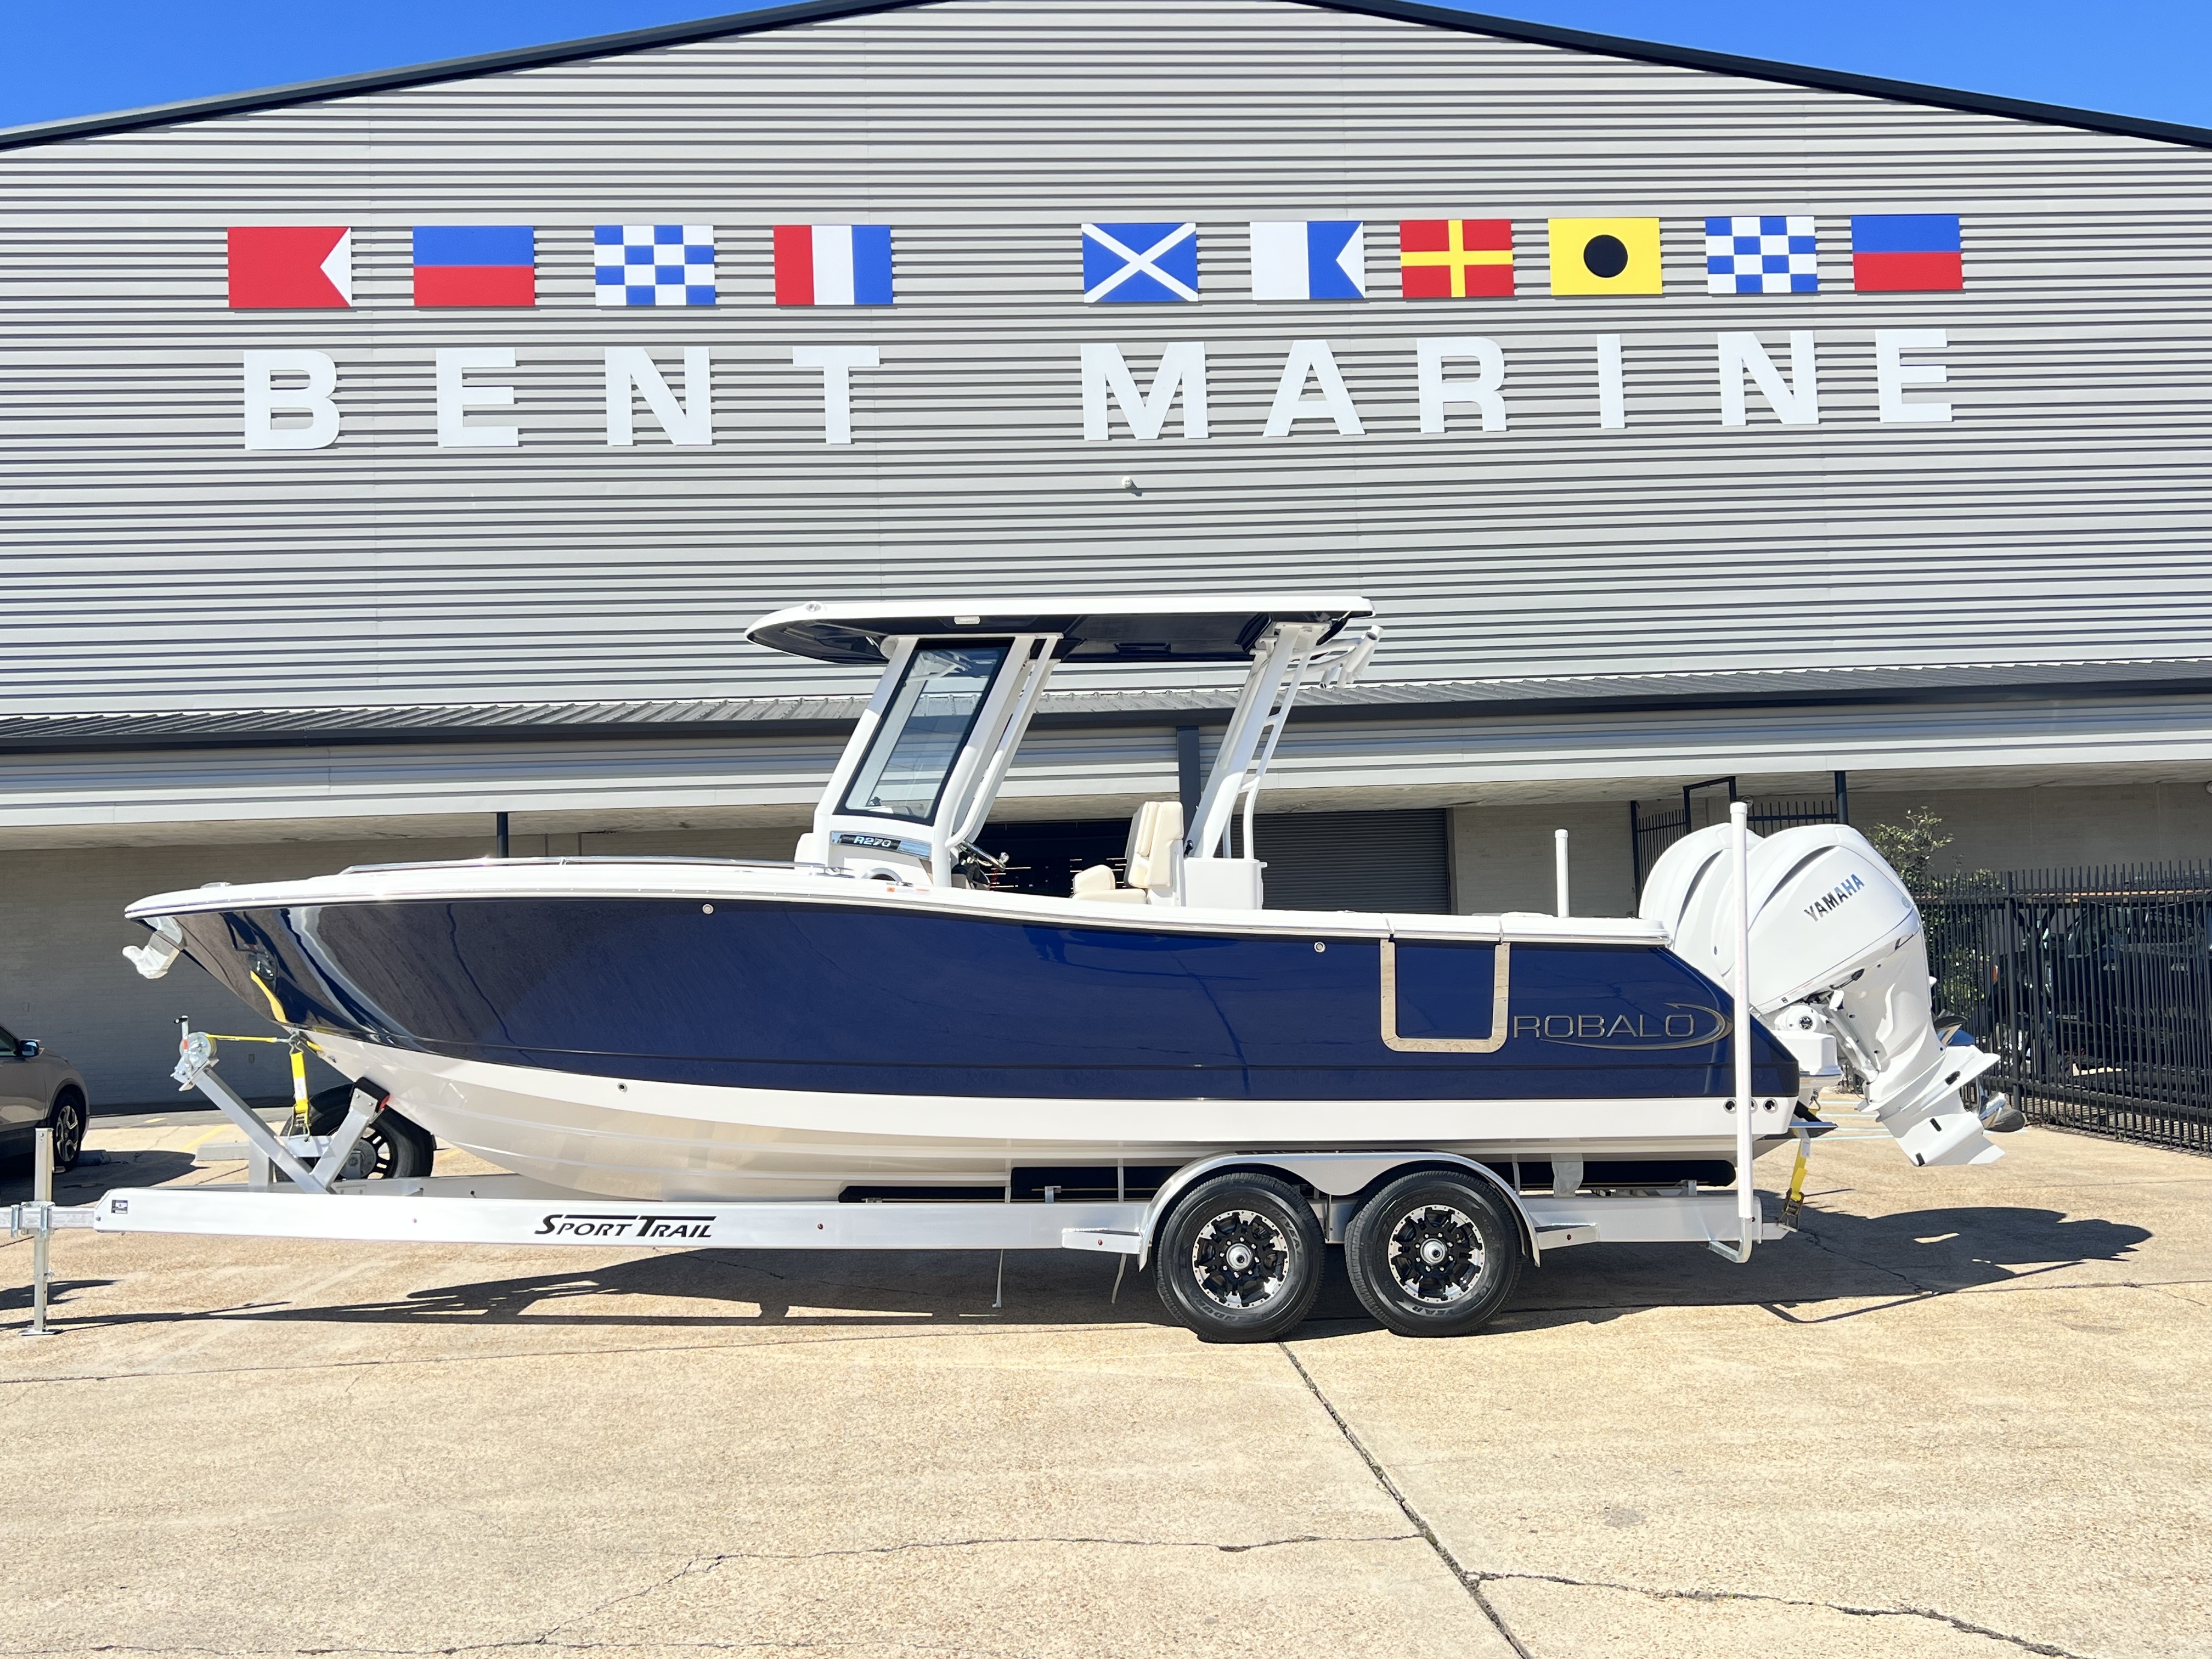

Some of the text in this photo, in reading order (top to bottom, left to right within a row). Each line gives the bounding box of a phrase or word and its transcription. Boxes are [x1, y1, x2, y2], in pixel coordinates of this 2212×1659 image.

[243, 328, 1953, 450] BENT MARINE
[853, 836, 891, 848] R270
[1803, 873, 1865, 922] YAMAHA
[1513, 1014, 1695, 1038] ROBALO
[533, 1214, 718, 1238] SPORT TRAIL
